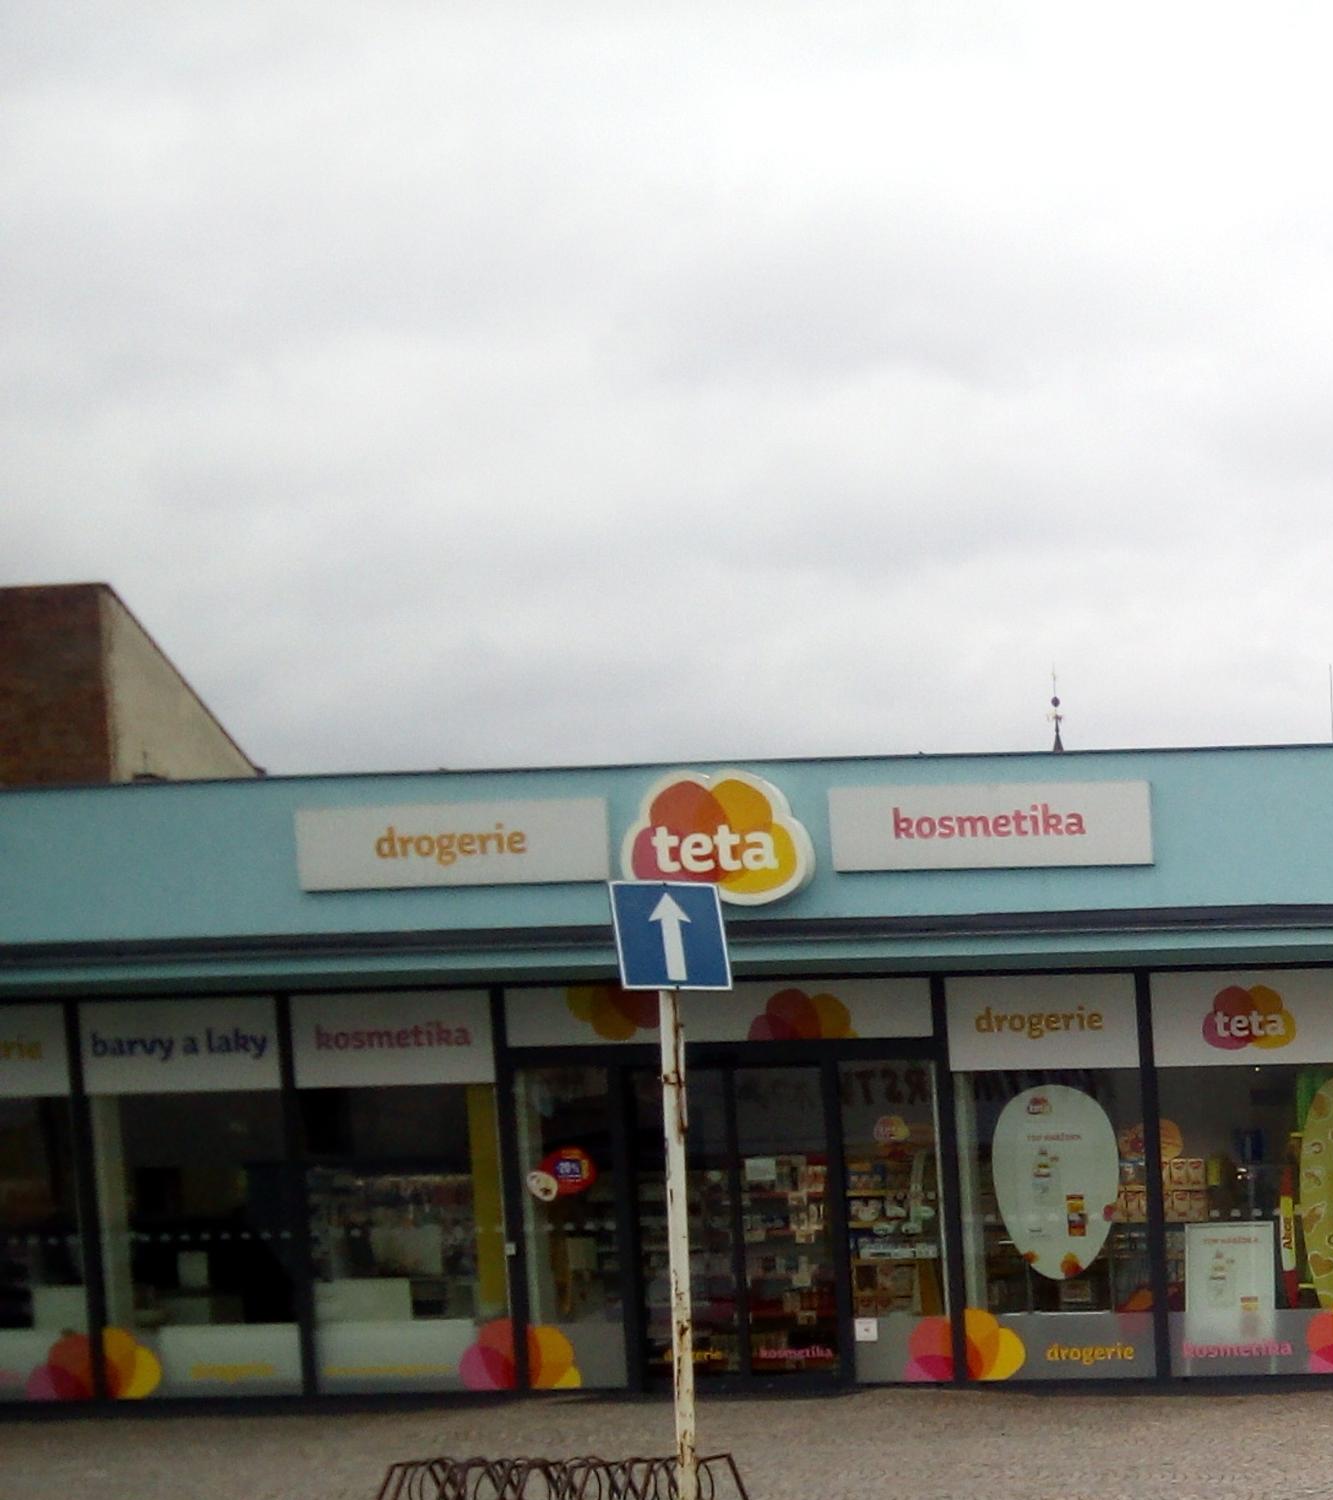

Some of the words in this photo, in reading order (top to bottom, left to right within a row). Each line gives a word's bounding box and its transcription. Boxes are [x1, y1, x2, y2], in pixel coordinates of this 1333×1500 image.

[892, 803, 1087, 840] kosmetika
[374, 822, 528, 867] drogerie
[651, 823, 779, 873] teta
[314, 1021, 472, 1051] kosmetika
[975, 1005, 1103, 1040] drogerie
[1213, 1009, 1286, 1037] teta
[91, 1029, 174, 1062] barvy
[182, 1036, 199, 1055] a
[205, 1026, 268, 1060] laky
[1046, 1342, 1134, 1366] drogerie
